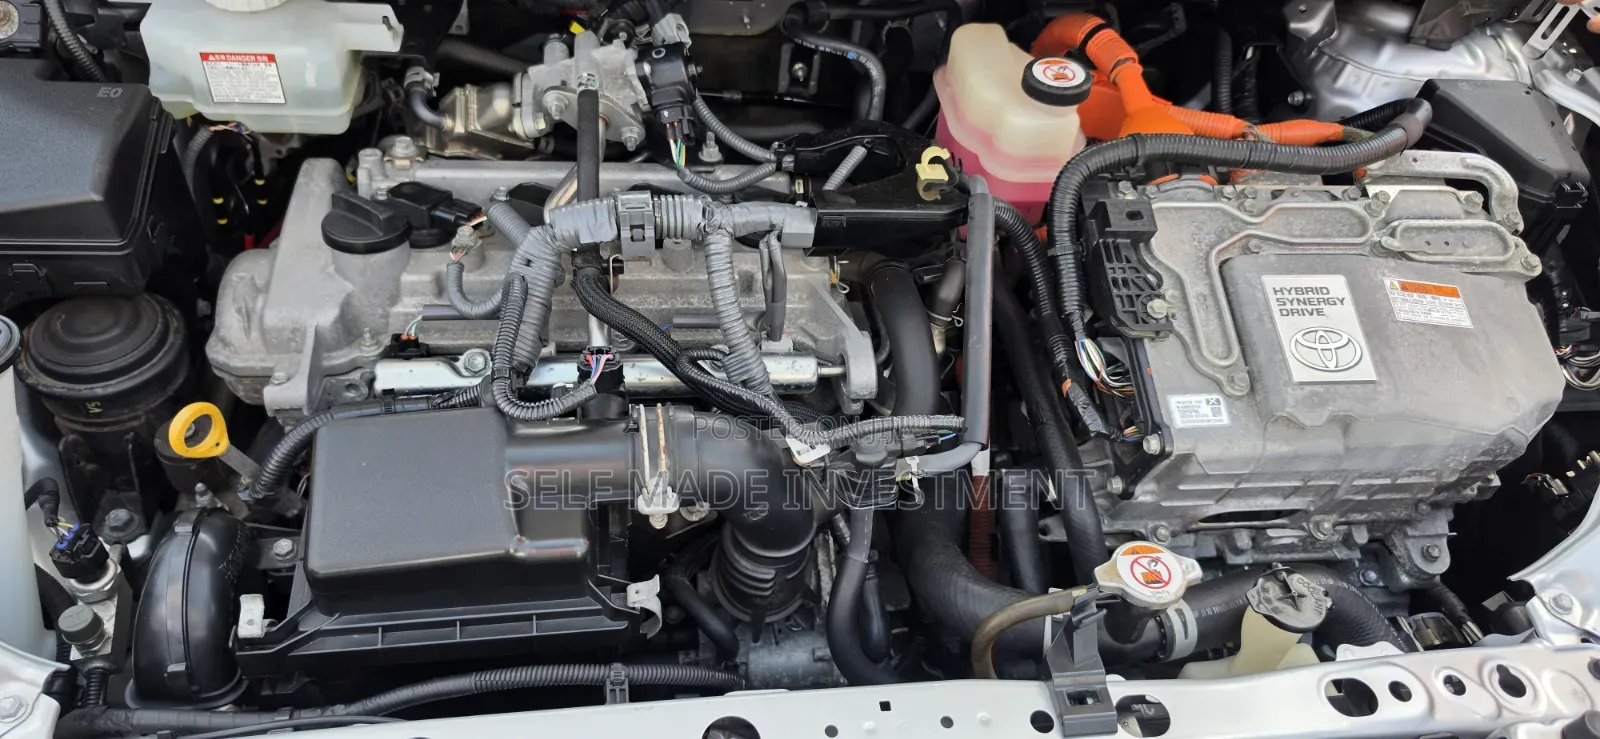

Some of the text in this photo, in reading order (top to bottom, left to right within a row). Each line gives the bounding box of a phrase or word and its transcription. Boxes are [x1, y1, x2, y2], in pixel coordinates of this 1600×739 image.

[226, 54, 256, 62] DANGER
[1272, 286, 1330, 296] HYBRID
[1275, 297, 1346, 307] SYNERGY
[1279, 308, 1326, 317] DRIVE
